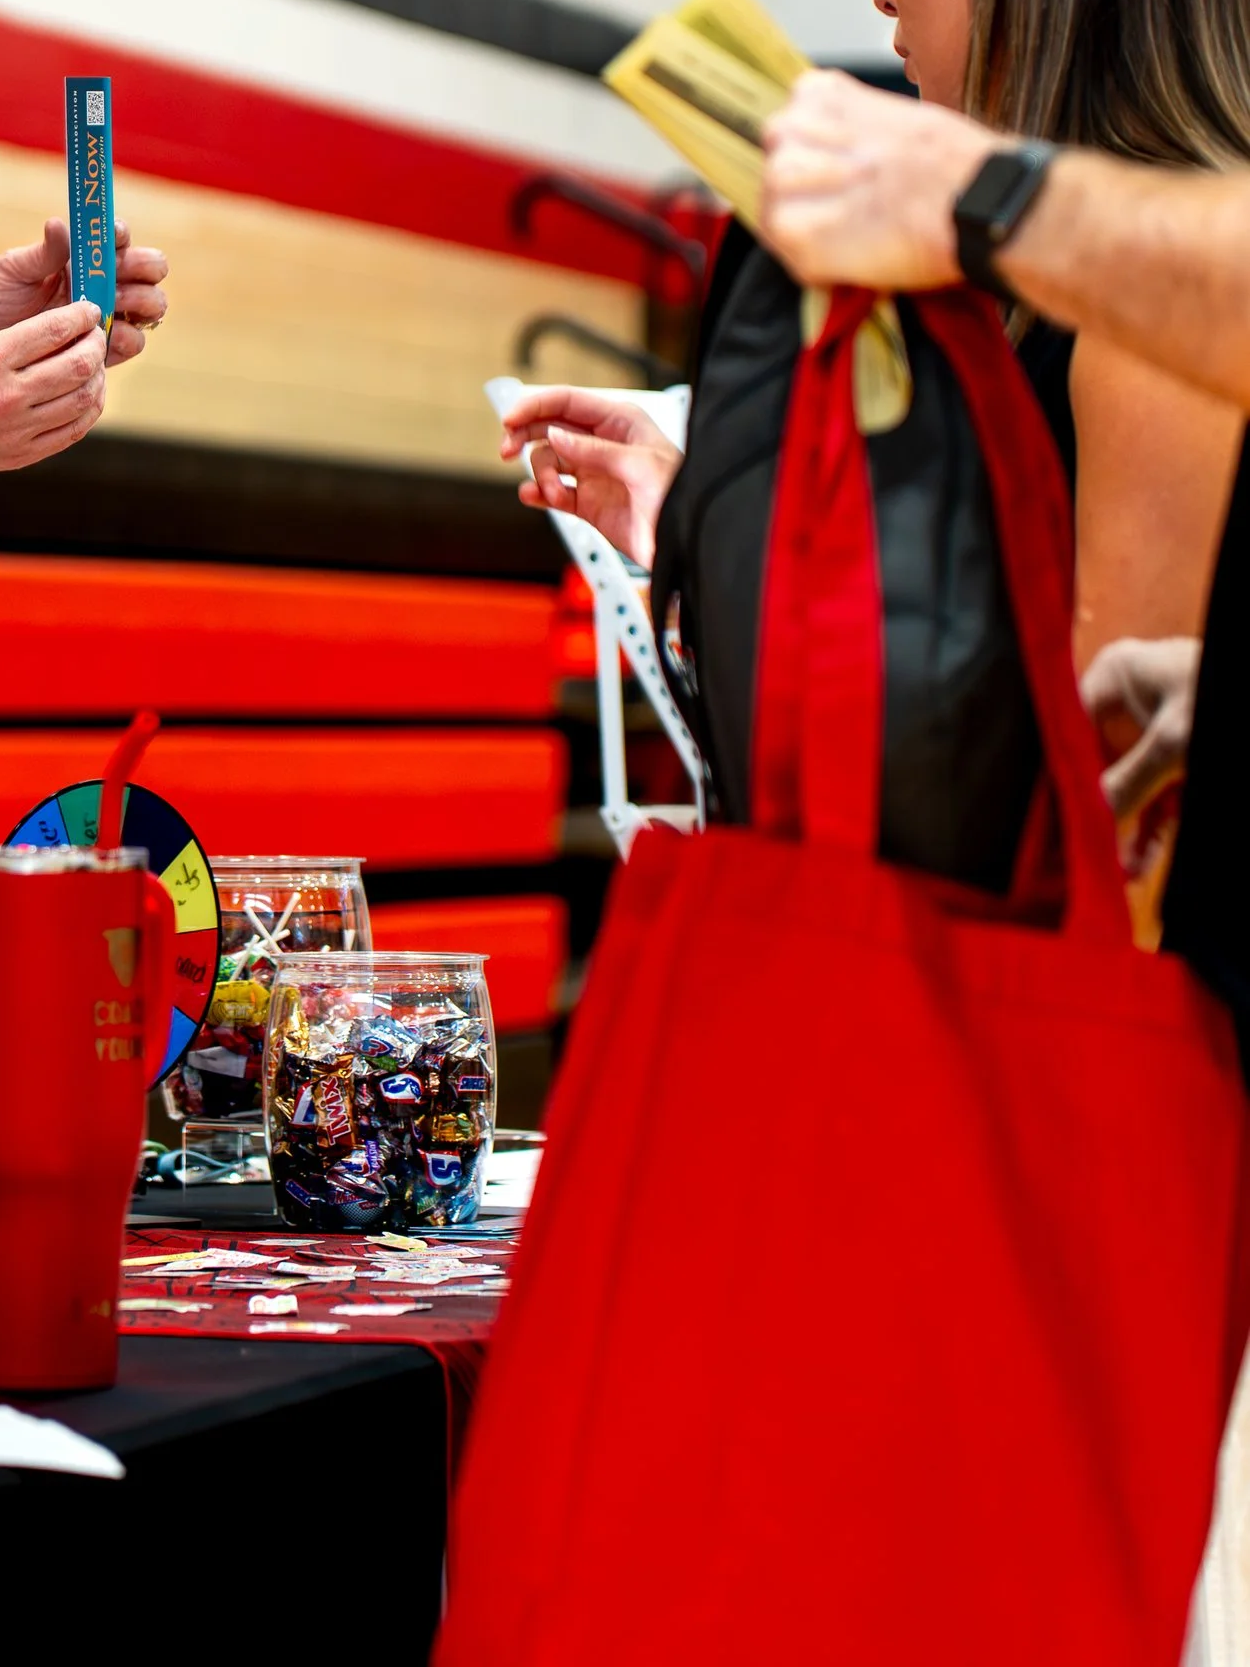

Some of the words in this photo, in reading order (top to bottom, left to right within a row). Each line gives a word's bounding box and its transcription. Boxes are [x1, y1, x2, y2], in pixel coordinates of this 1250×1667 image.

[83, 132, 99, 206] Now
[99, 136, 107, 243] www.msta.org/join
[88, 218, 106, 278] Join
